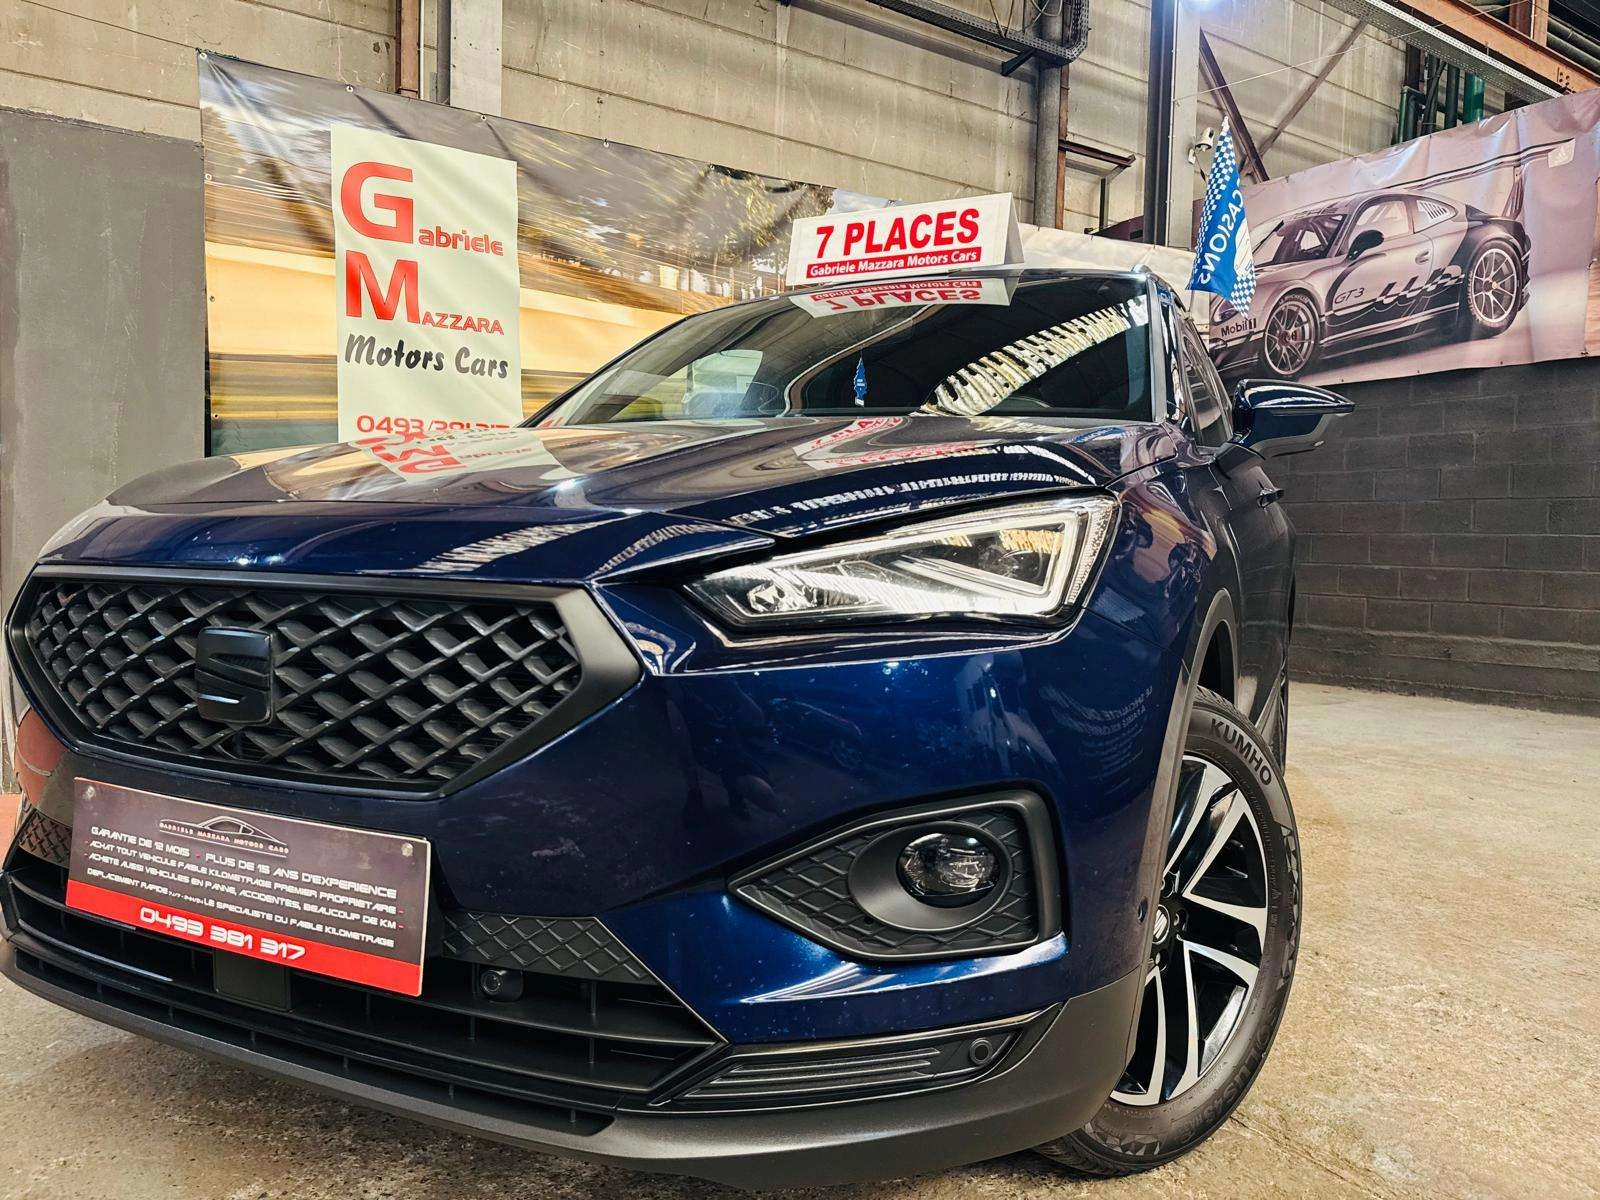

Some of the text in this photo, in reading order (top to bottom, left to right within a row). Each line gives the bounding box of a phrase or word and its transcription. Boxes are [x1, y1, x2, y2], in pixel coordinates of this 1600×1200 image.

[816, 208, 980, 259] 7 PLACES
[810, 248, 977, 277] Gabriele Mazzara Motors Cars
[1335, 287, 1365, 304] GT3
[344, 333, 509, 379] Motors Cars
[1210, 718, 1272, 786] KUMHO
[90, 840, 115, 852] ACHAT
[116, 846, 137, 857] TOUT
[208, 868, 273, 889] KILOMETRAGE
[273, 882, 318, 899] PREMIER
[91, 826, 137, 844] GARANTIE
[138, 837, 152, 849] DE
[165, 845, 190, 858] MOIS
[205, 853, 236, 867] PLUS
[238, 860, 255, 871] DE
[257, 864, 270, 875] 15
[273, 867, 299, 880] ANS
[301, 872, 397, 899] D'EXPERIENCE
[191, 877, 204, 887] EN
[303, 903, 361, 921] BEAUCOUP
[362, 915, 378, 926] DE
[379, 918, 397, 929] KM
[204, 897, 215, 907] LE
[274, 914, 289, 925] DU
[139, 906, 306, 960] 0493 381 317
